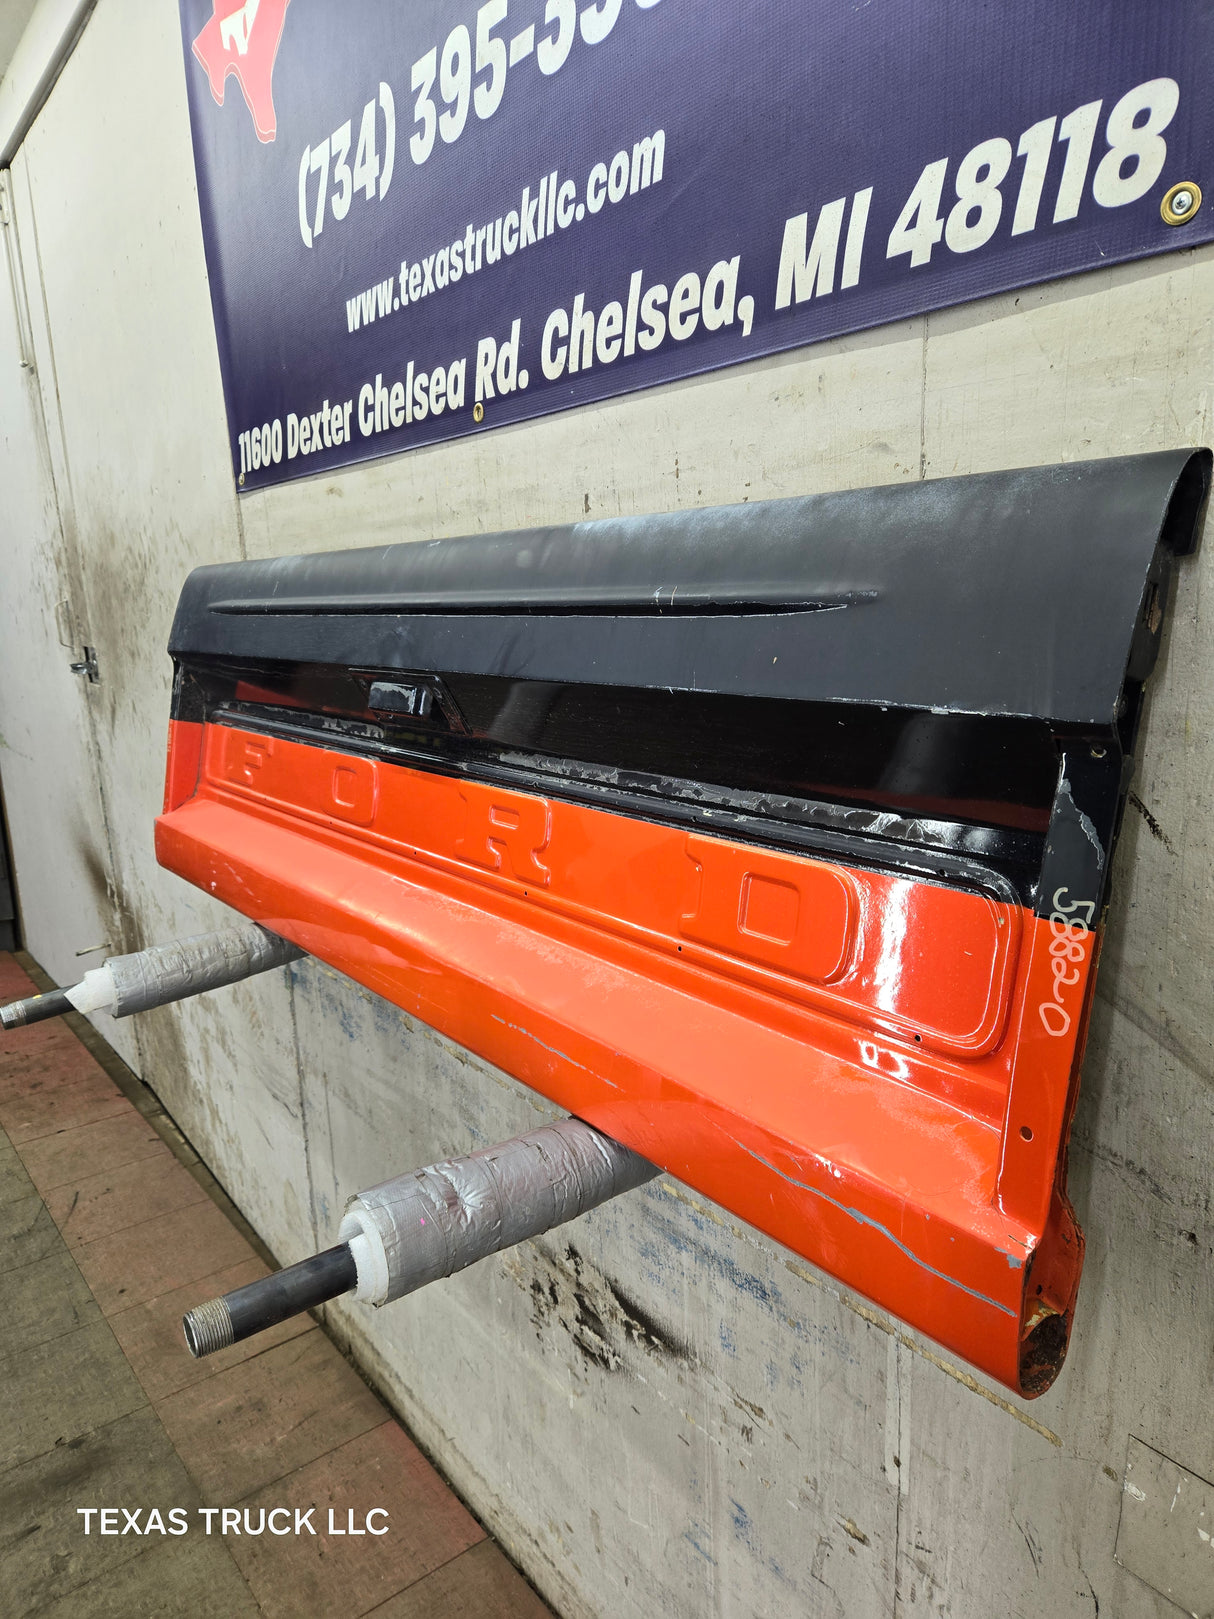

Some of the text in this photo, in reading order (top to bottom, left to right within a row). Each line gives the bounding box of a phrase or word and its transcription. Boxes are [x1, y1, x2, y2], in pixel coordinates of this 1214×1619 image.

[298, 81, 396, 249] (734)
[346, 129, 666, 333] www.texastruckllc.com
[238, 77, 1180, 478] 11600 Dexter Chelsea Rd. Chelsea, MI 48118
[1039, 887, 1097, 1037] 58820
